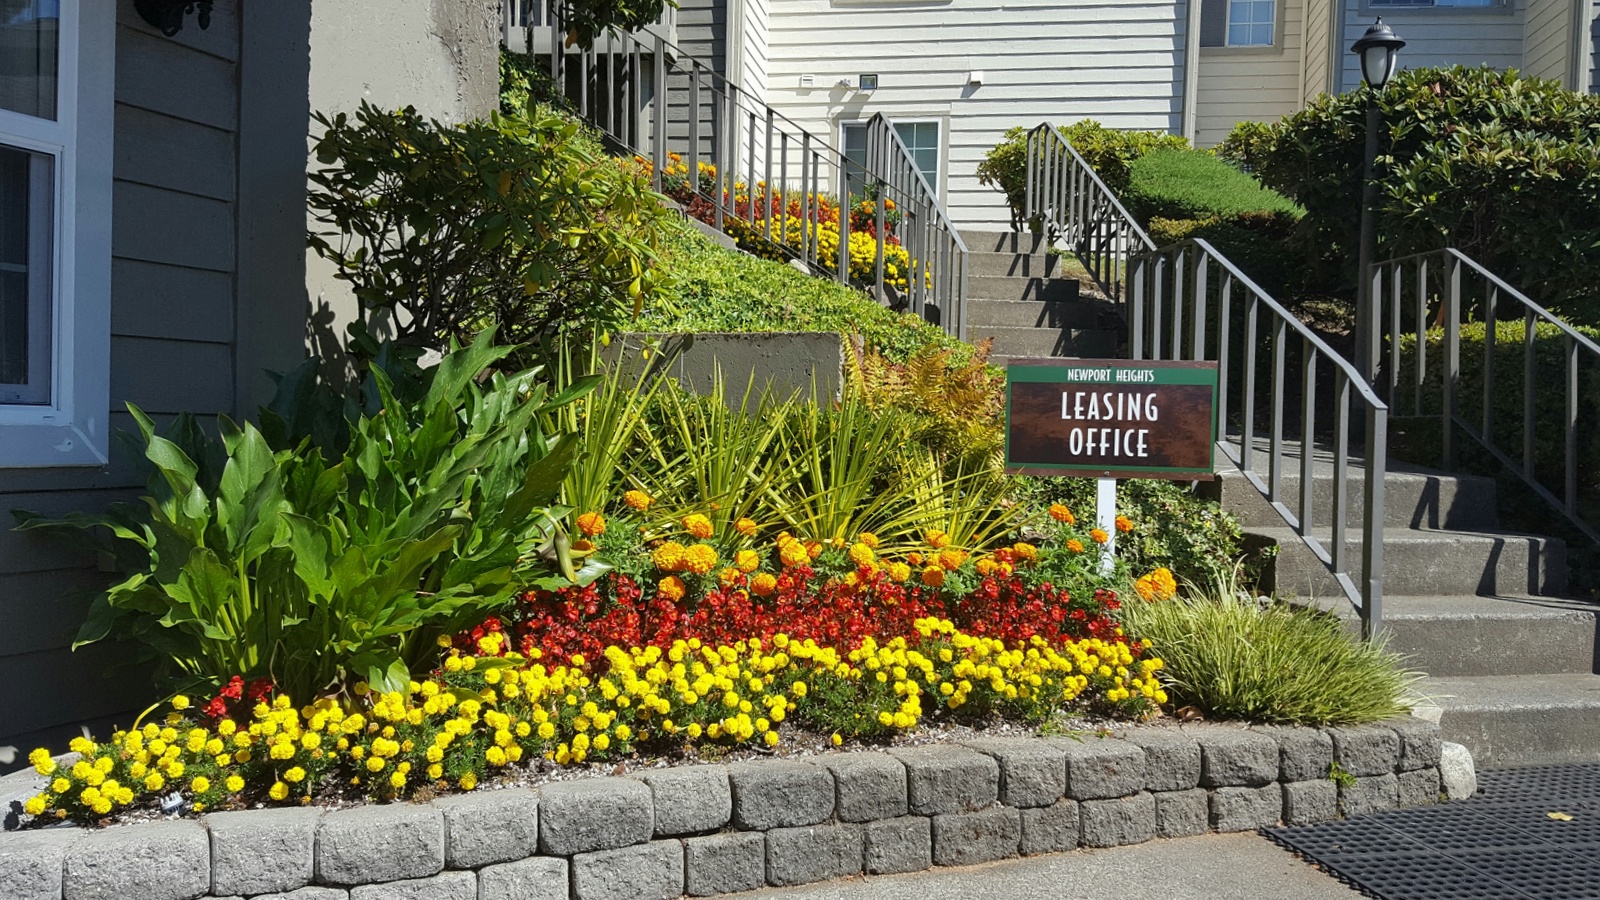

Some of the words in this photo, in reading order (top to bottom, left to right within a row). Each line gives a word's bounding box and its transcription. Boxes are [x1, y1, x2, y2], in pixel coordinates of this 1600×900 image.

[1067, 369, 1111, 382] NEWPORT
[1116, 369, 1155, 382] HEIGHTS
[1061, 391, 1159, 422] LEASING
[1069, 427, 1149, 457] OFFICE
